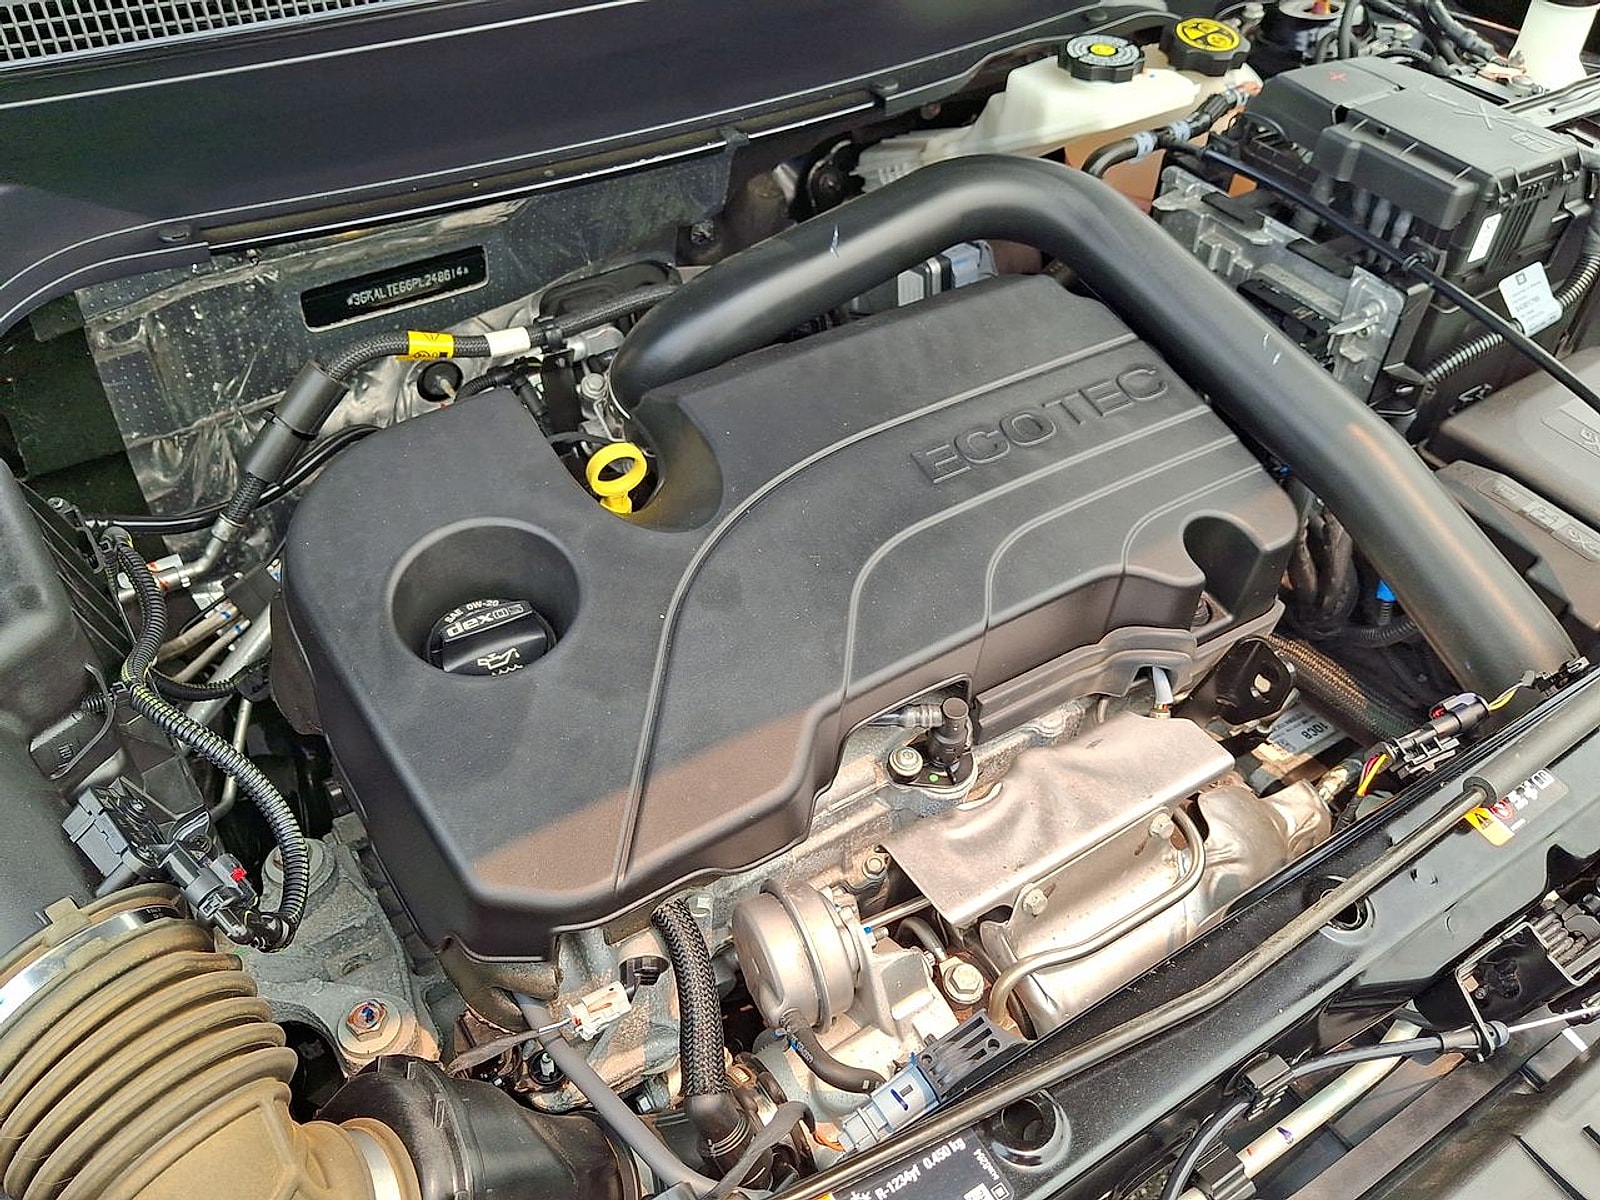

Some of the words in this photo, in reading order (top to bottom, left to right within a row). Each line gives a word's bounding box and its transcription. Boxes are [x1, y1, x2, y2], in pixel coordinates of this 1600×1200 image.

[910, 363, 1169, 484] ECOTEC
[445, 609, 464, 623] SAE
[466, 600, 499, 610] 0W-20
[446, 603, 524, 637] dexos
[874, 1163, 922, 1200] R-1234yf
[922, 1144, 951, 1170] 0.450
[950, 1137, 966, 1152] kg
